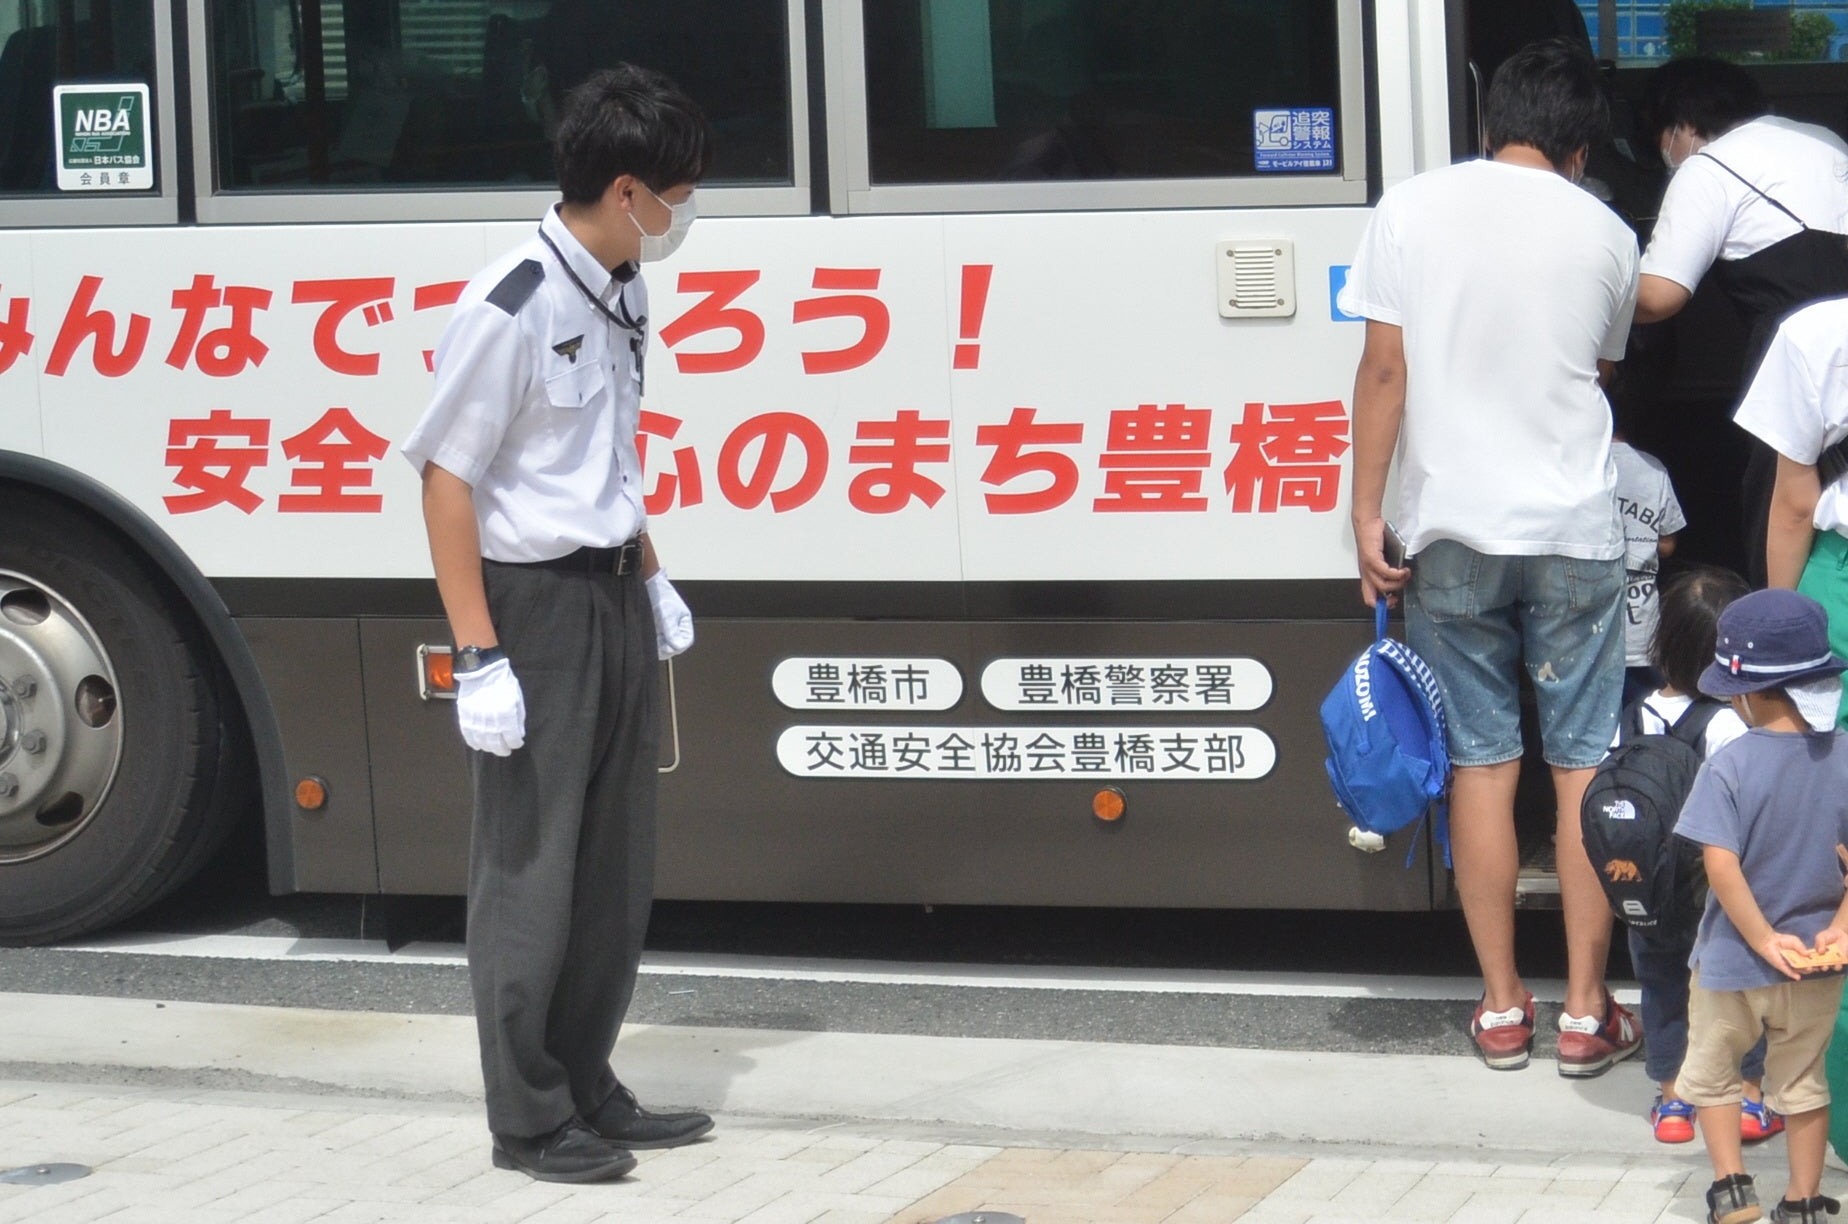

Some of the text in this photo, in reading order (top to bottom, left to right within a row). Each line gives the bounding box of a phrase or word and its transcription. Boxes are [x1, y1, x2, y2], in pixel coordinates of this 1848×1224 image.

[75, 109, 131, 132] NBA
[1292, 111, 1330, 126] 追突
[1293, 126, 1331, 141] 警報
[1293, 141, 1331, 149] システム
[94, 154, 140, 165] 日本バス協会
[80, 171, 131, 186] 会員章
[163, 400, 1352, 516] 安全心のまち豊橋
[805, 663, 930, 705] 豊橋市
[1018, 663, 1236, 706] 豊橋警察署
[805, 731, 1246, 773] 交通安全協会豊橋支部
